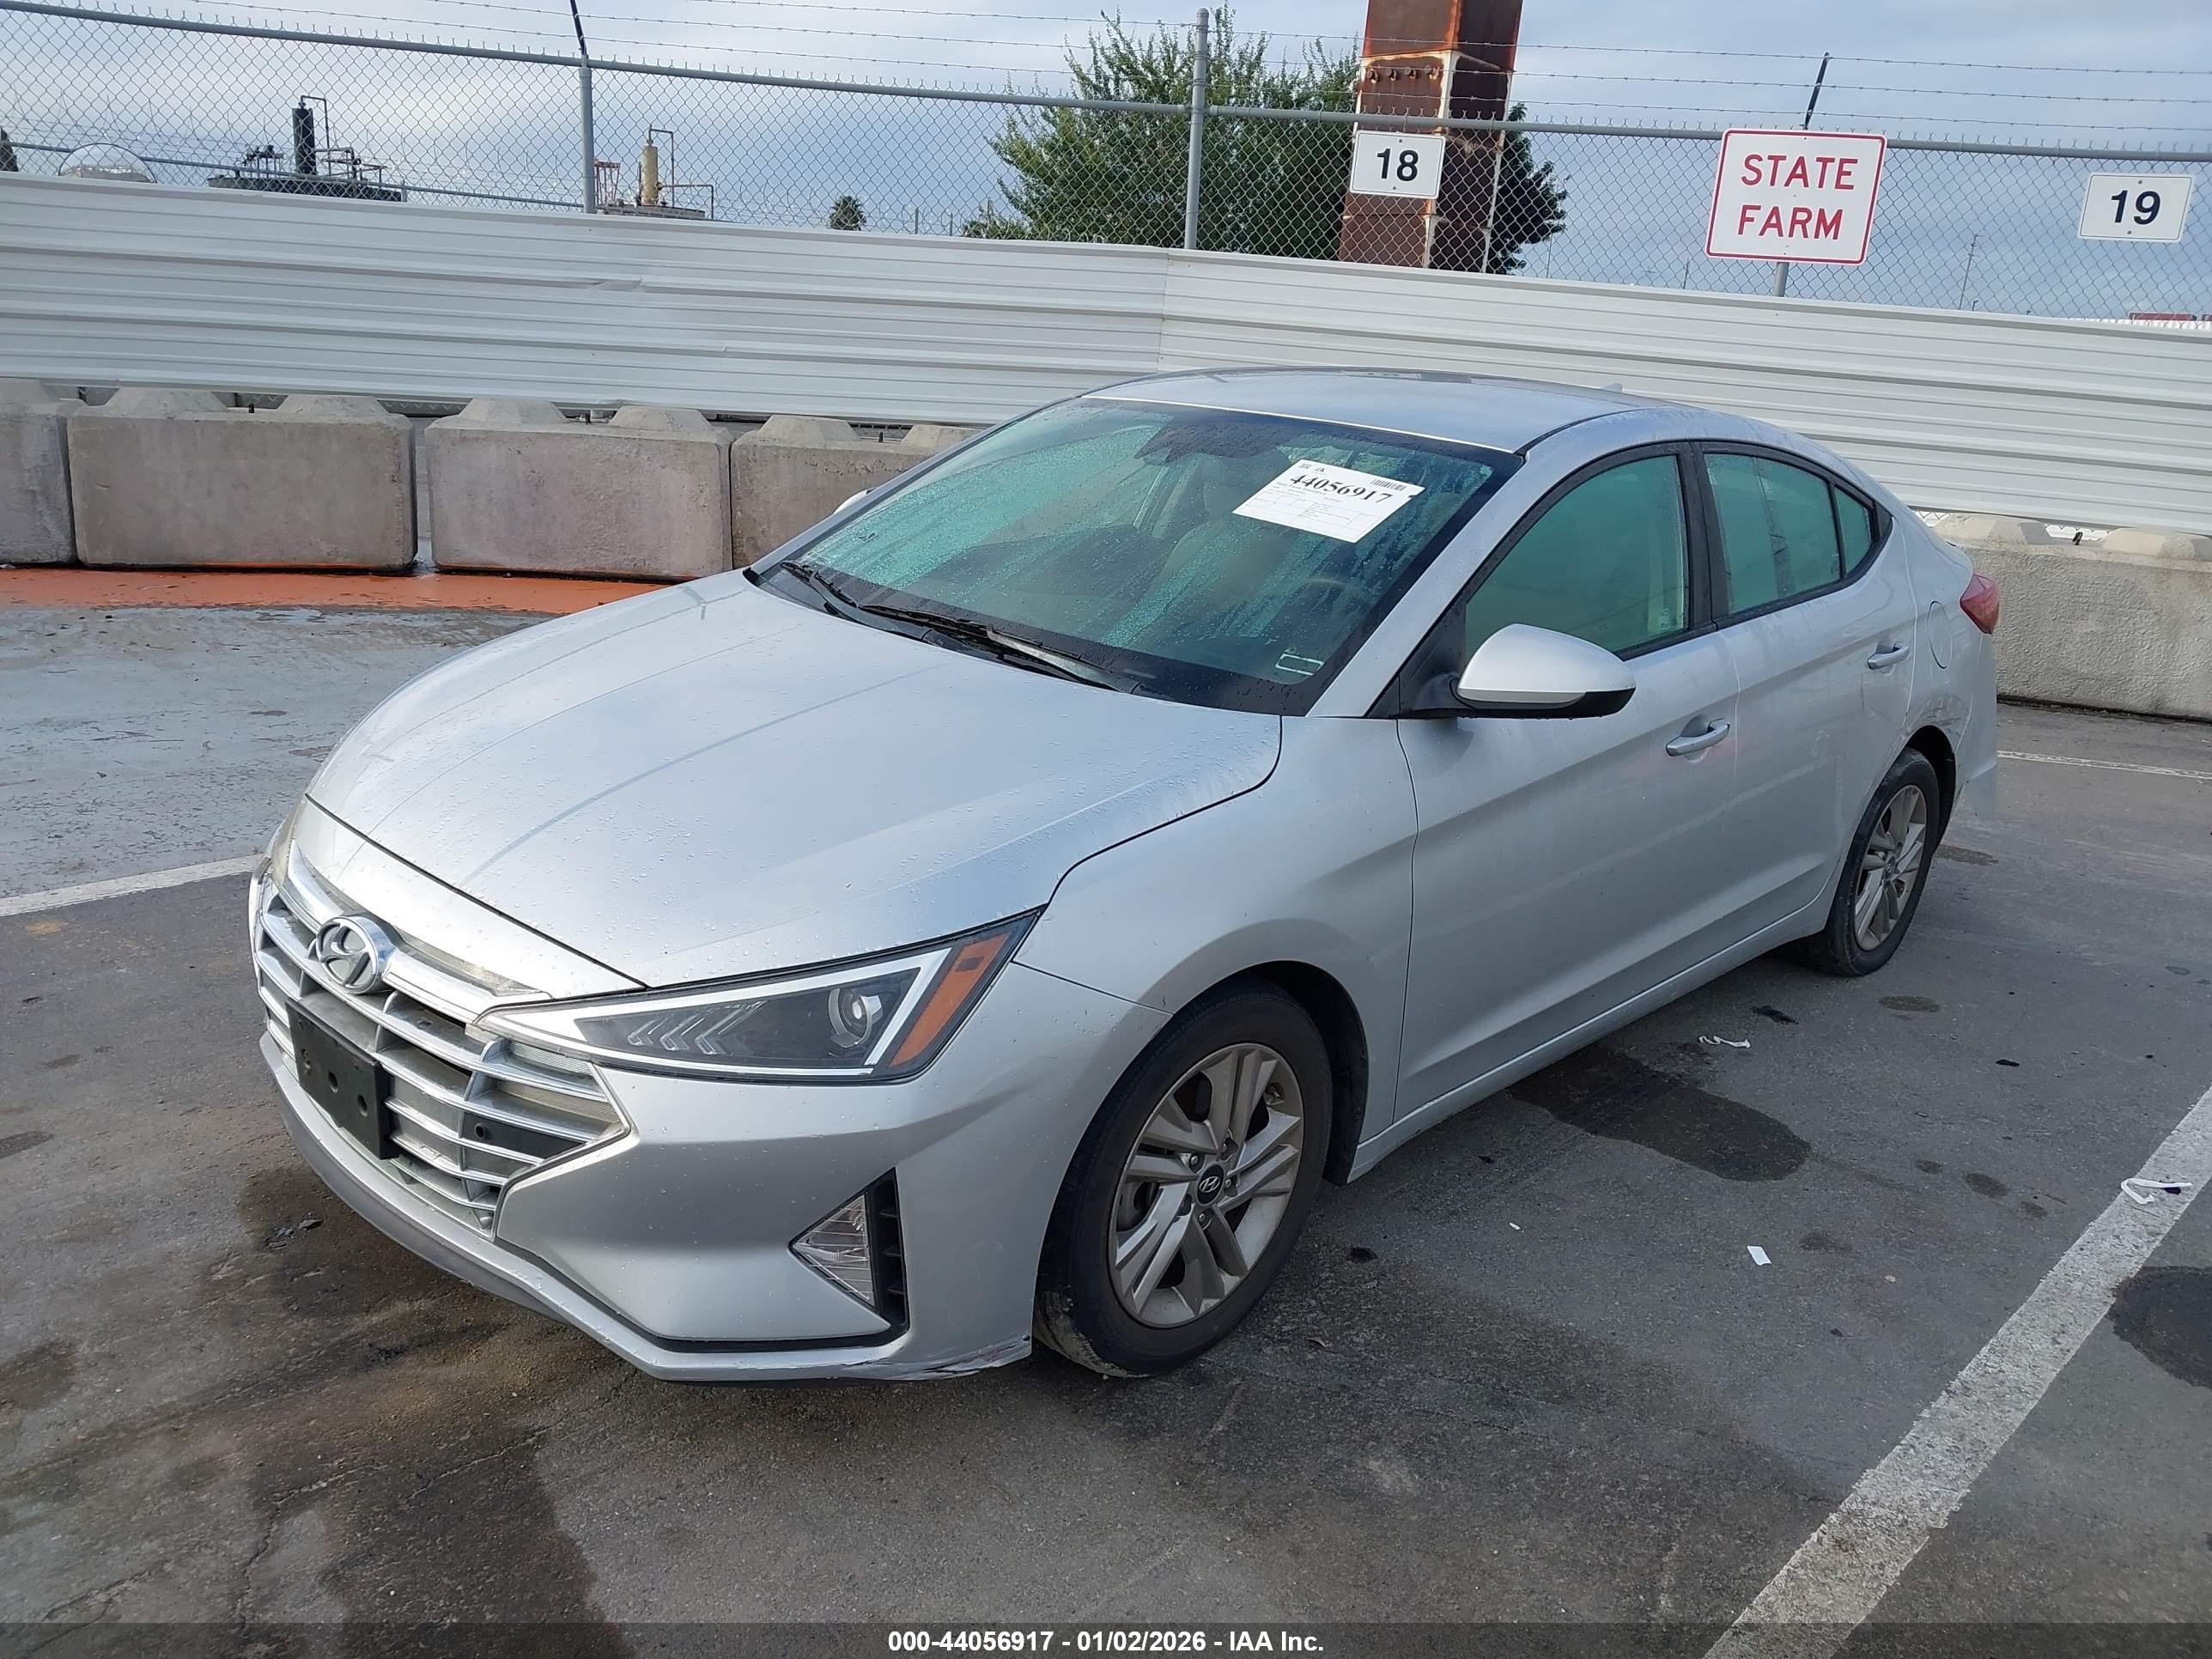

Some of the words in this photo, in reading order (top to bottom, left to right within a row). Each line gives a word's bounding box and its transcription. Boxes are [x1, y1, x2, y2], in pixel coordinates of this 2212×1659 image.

[1376, 148, 1419, 182] 18
[1741, 154, 1858, 190] STATE
[1737, 204, 1843, 240] FARM
[2111, 190, 2160, 225] 19
[1290, 474, 1393, 503] 44056917
